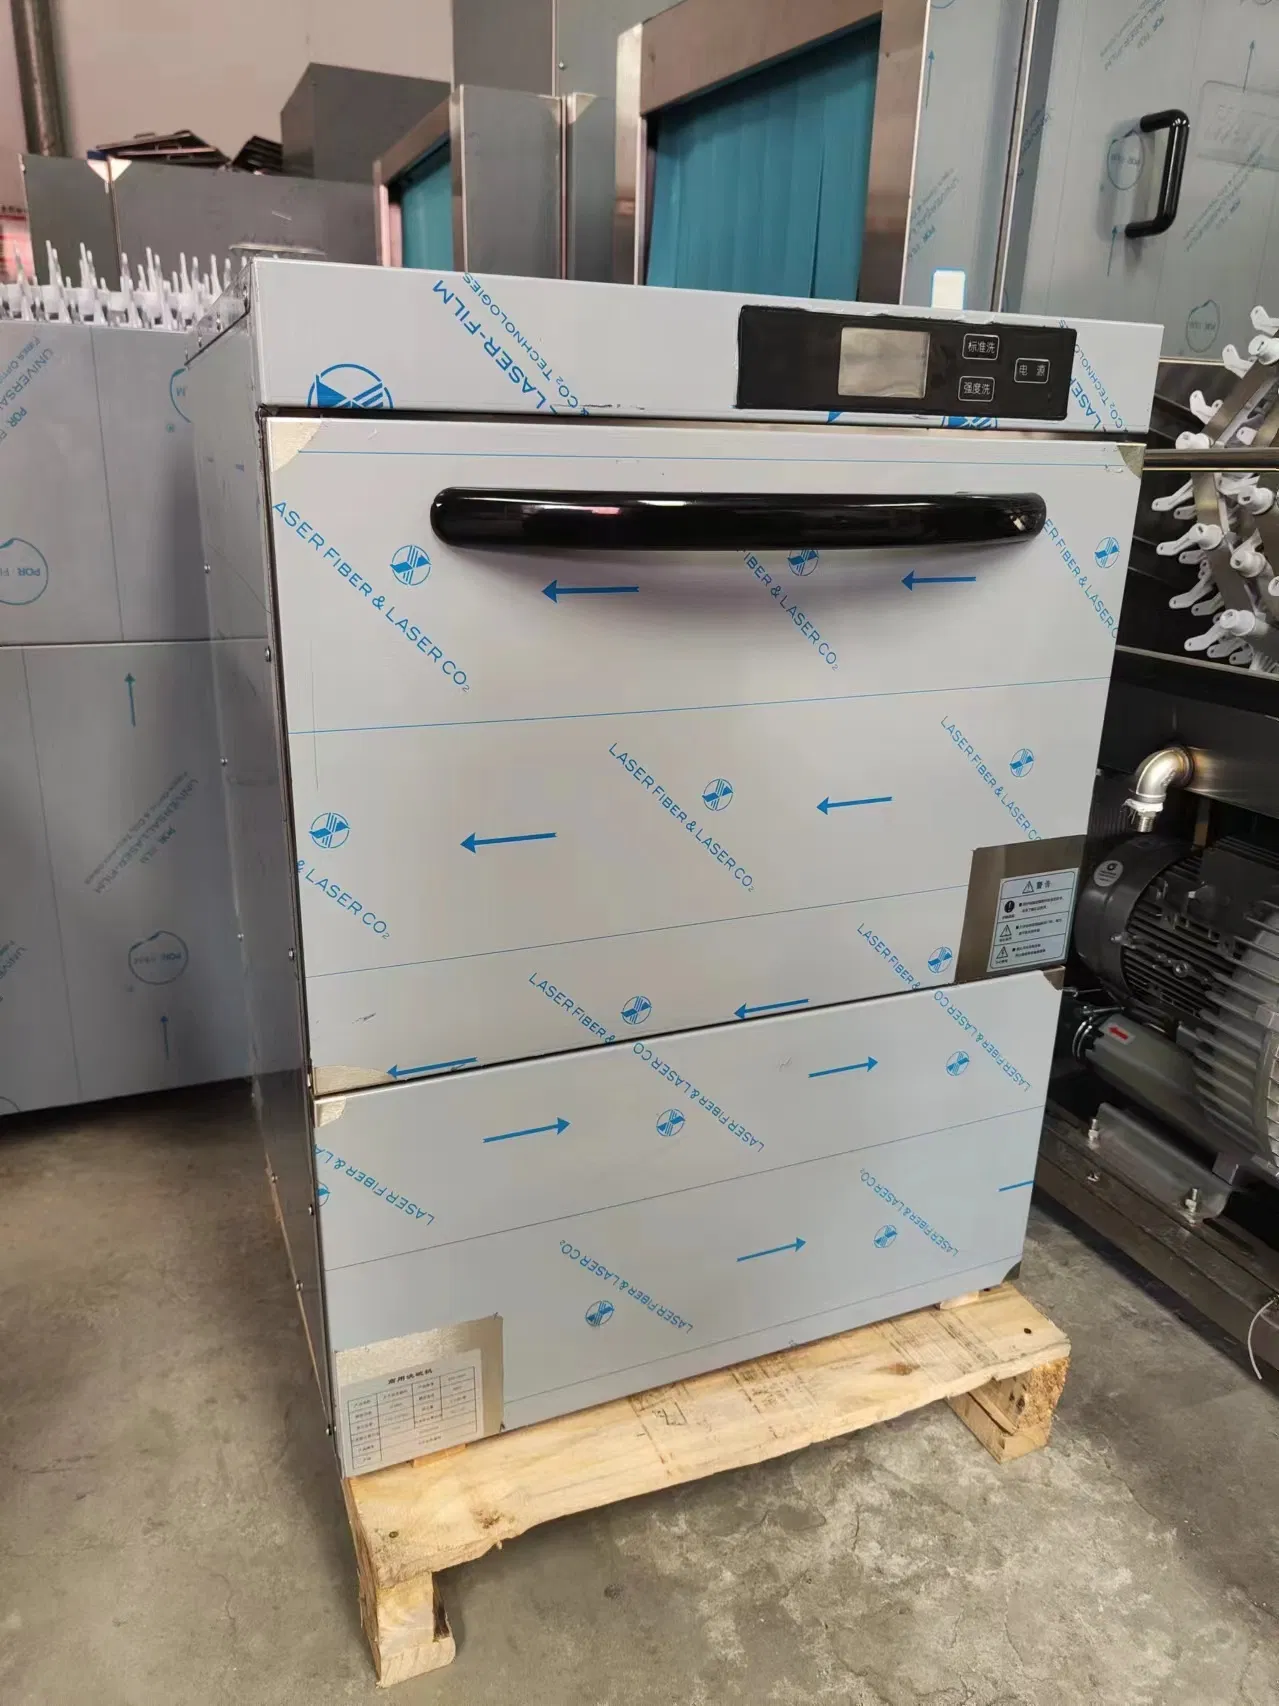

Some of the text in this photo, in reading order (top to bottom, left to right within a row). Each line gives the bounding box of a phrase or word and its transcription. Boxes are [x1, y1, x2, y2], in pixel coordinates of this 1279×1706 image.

[462, 272, 553, 381] TECHNOLOGIES
[433, 280, 546, 410] LASER-FILM
[968, 341, 996, 354] 标准洗
[963, 381, 991, 395] 强度洗
[740, 550, 772, 587] IBER
[770, 585, 782, 599] &
[780, 595, 821, 645] LASER
[1056, 538, 1081, 577] FIBER
[1078, 576, 1088, 588] &
[1084, 584, 1114, 628] LASER
[323, 547, 373, 597] FIBER
[371, 595, 386, 611] &
[385, 606, 443, 663] LASER
[940, 715, 975, 757] LASER
[970, 754, 997, 788] FIBER
[994, 786, 1004, 798] &
[1000, 793, 1031, 831] LASER
[608, 742, 655, 790] LASER
[652, 785, 688, 824] FIBER
[685, 820, 697, 833] &
[695, 828, 737, 871] LASER
[305, 868, 363, 916] LASER
[856, 923, 891, 960] LASER
[888, 956, 914, 985] FIBER
[528, 972, 574, 1012] LASER
[571, 1006, 606, 1039] FIBER
[947, 1006, 978, 1037] LASER
[975, 1032, 984, 1043] &
[982, 1039, 1004, 1067] FIBER
[651, 1055, 692, 1093] LASER
[1002, 1061, 1032, 1092] LASER
[689, 1088, 701, 1100] &
[698, 1095, 730, 1125] FIBER
[727, 1118, 765, 1153] LASER
[334, 1157, 347, 1170] &
[345, 1166, 388, 1196] FIBER
[385, 1191, 436, 1226] LASER
[874, 1184, 905, 1212] LASER
[902, 1207, 912, 1216] &
[909, 1212, 934, 1237] FIBER
[930, 1231, 959, 1257] LASER
[579, 1255, 621, 1286] LASER
[619, 1280, 629, 1291] &
[627, 1287, 659, 1312] FIBER
[656, 1305, 694, 1334] LASER
